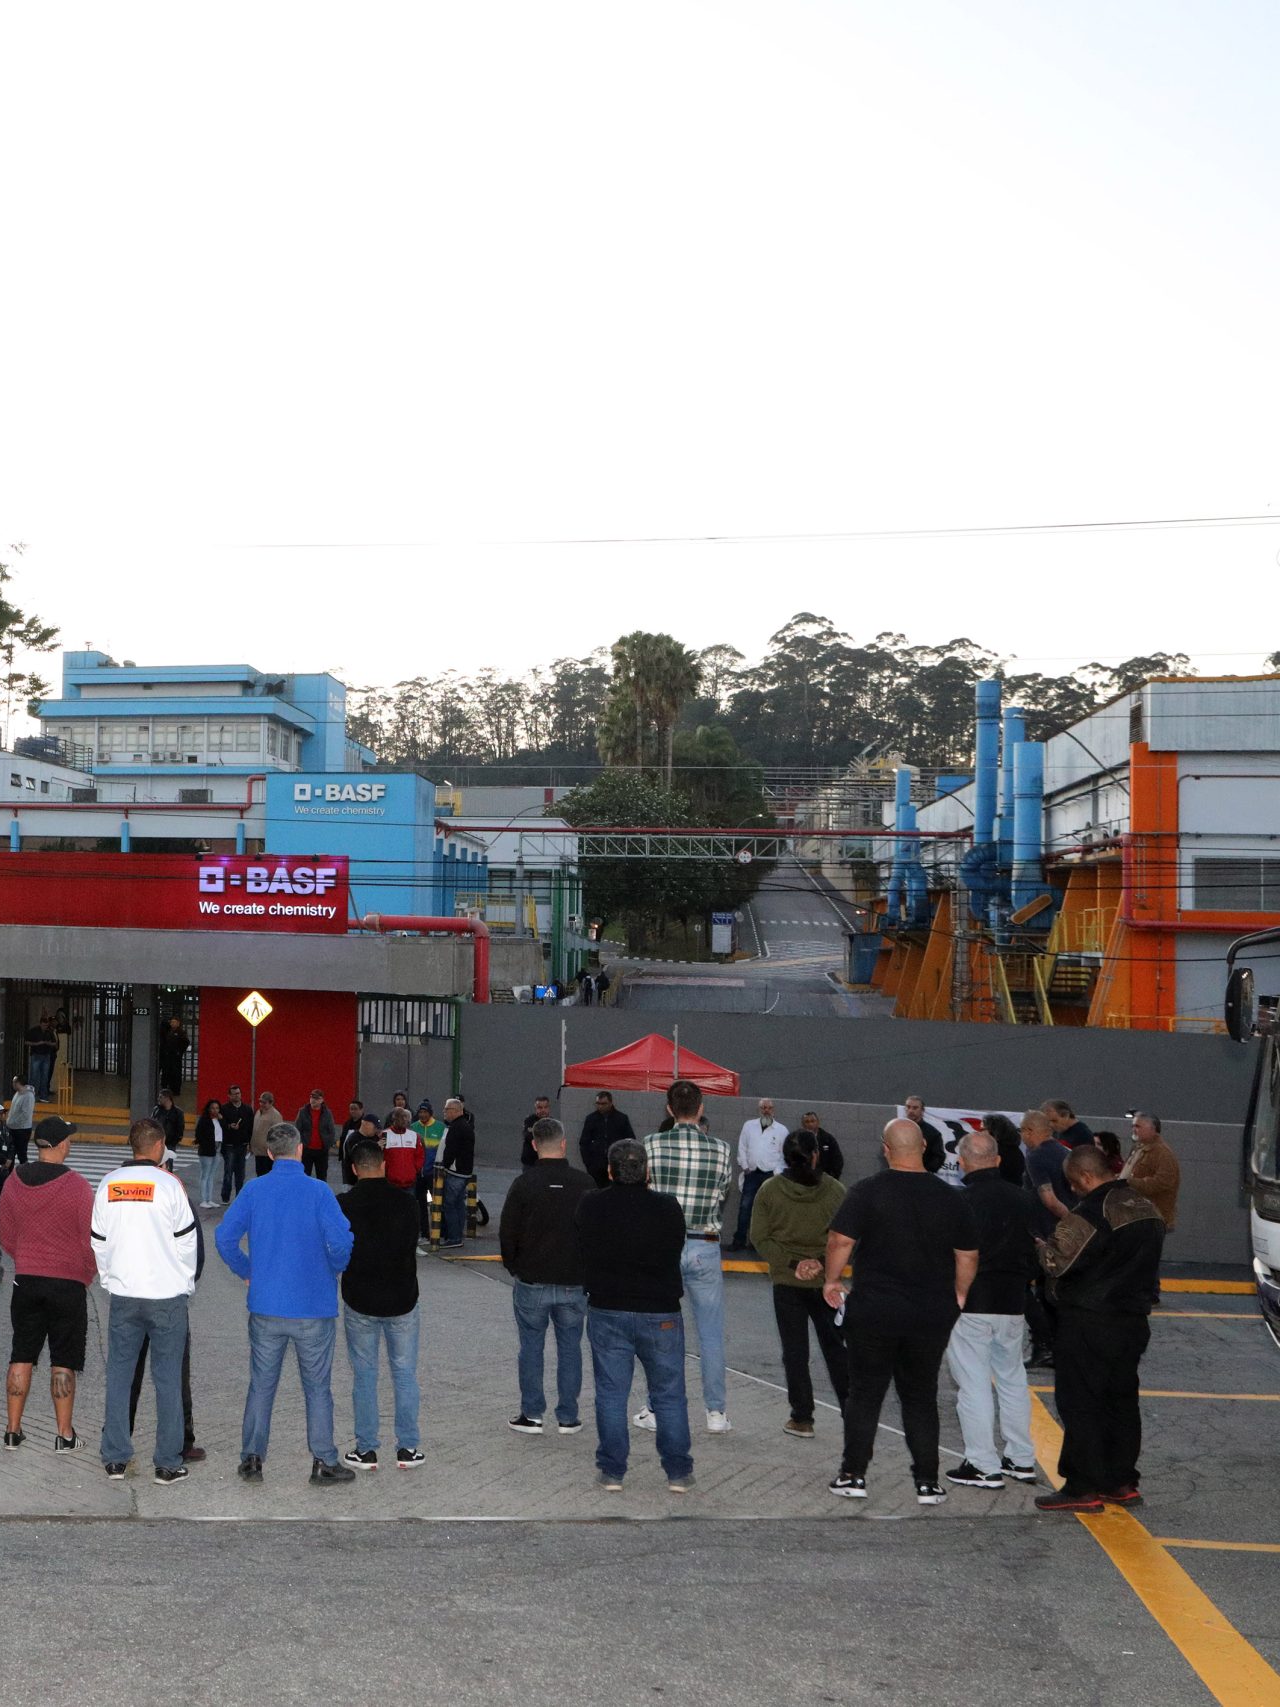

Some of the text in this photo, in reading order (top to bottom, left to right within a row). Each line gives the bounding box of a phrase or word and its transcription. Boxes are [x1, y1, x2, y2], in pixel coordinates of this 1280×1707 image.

[325, 783, 386, 802] BASF
[294, 805, 385, 817] We create chemistry
[246, 867, 337, 895] BASF
[199, 902, 337, 919] We create chemistry
[112, 1186, 152, 1196] Suvinil
